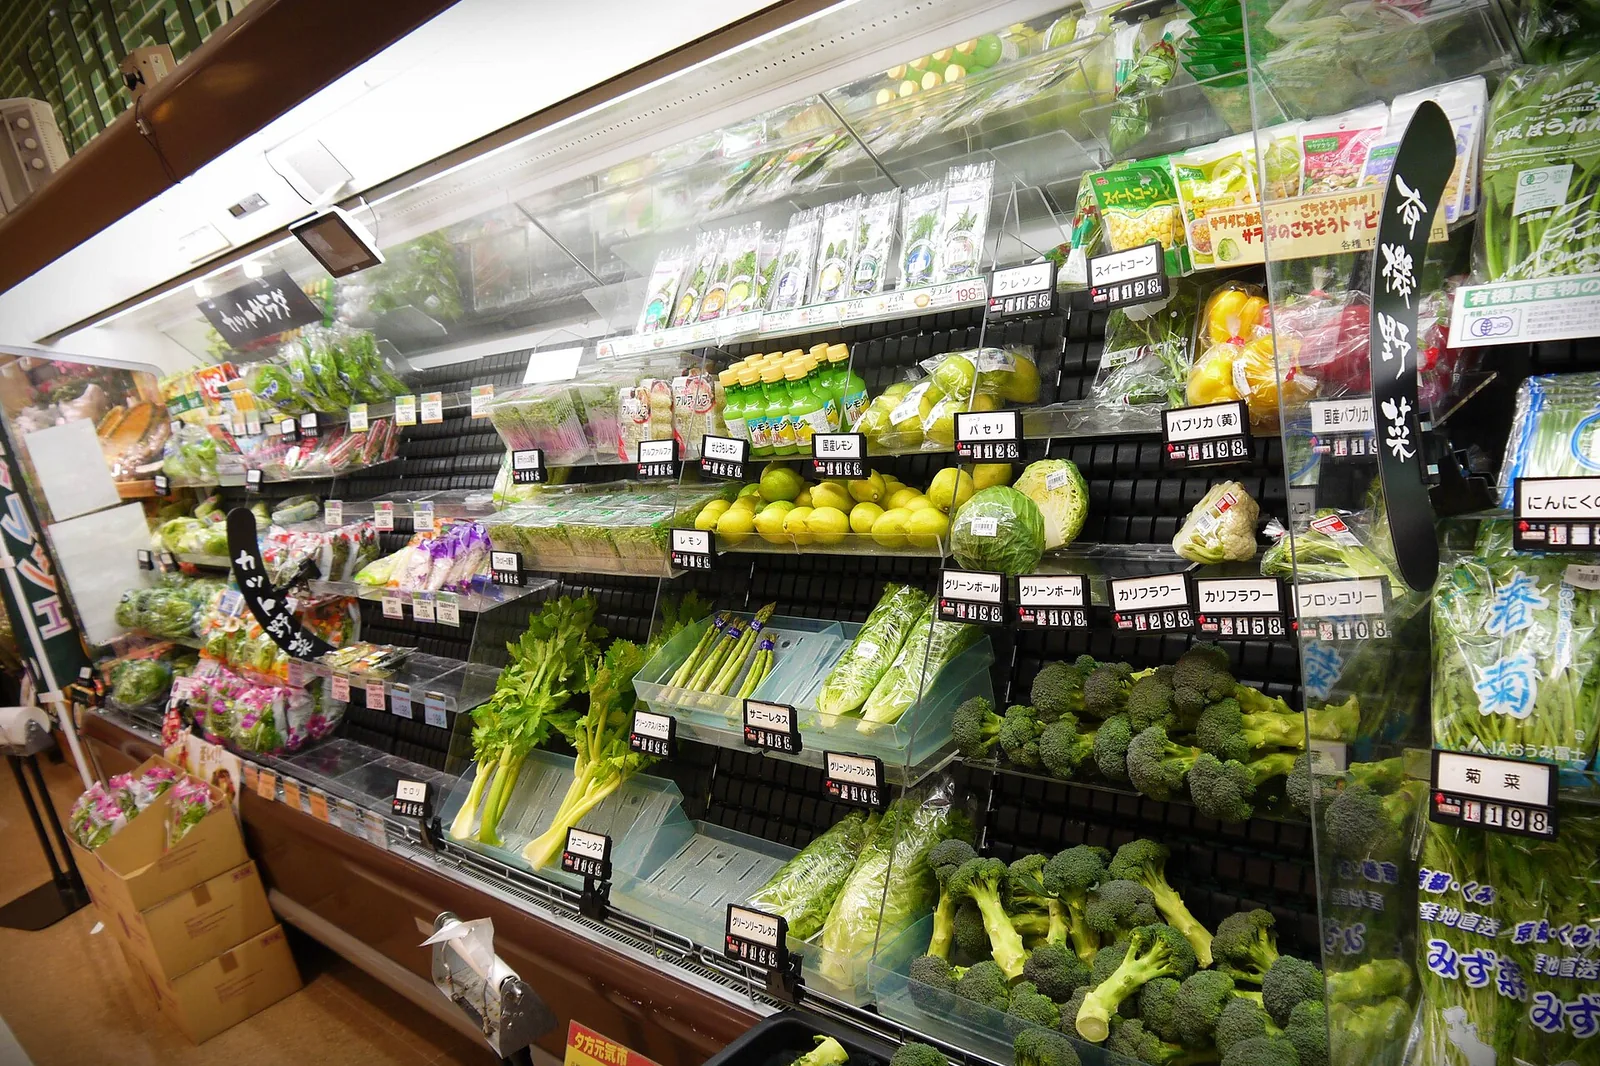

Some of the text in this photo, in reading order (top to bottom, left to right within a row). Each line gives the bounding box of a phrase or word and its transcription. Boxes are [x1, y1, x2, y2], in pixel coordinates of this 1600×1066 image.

[1102, 187, 1159, 205] スイートコーン
[1095, 256, 1154, 278] スイートコーン
[1170, 412, 1239, 433] パプリカ(黄)
[823, 439, 854, 452] 国産レモン
[680, 536, 702, 546] レモン
[944, 579, 1000, 594] グリーンボール
[1021, 585, 1082, 597] グリーンボール
[1118, 585, 1181, 602] カリフラワー
[1204, 590, 1274, 603] カリフラワー
[1300, 590, 1377, 608] ブロッコリー
[749, 709, 789, 725] サニーレタス
[830, 761, 876, 777] グリーンリーフレタス
[571, 836, 603, 853] サニーレタス
[732, 916, 777, 938] グリーンリーフレタス
